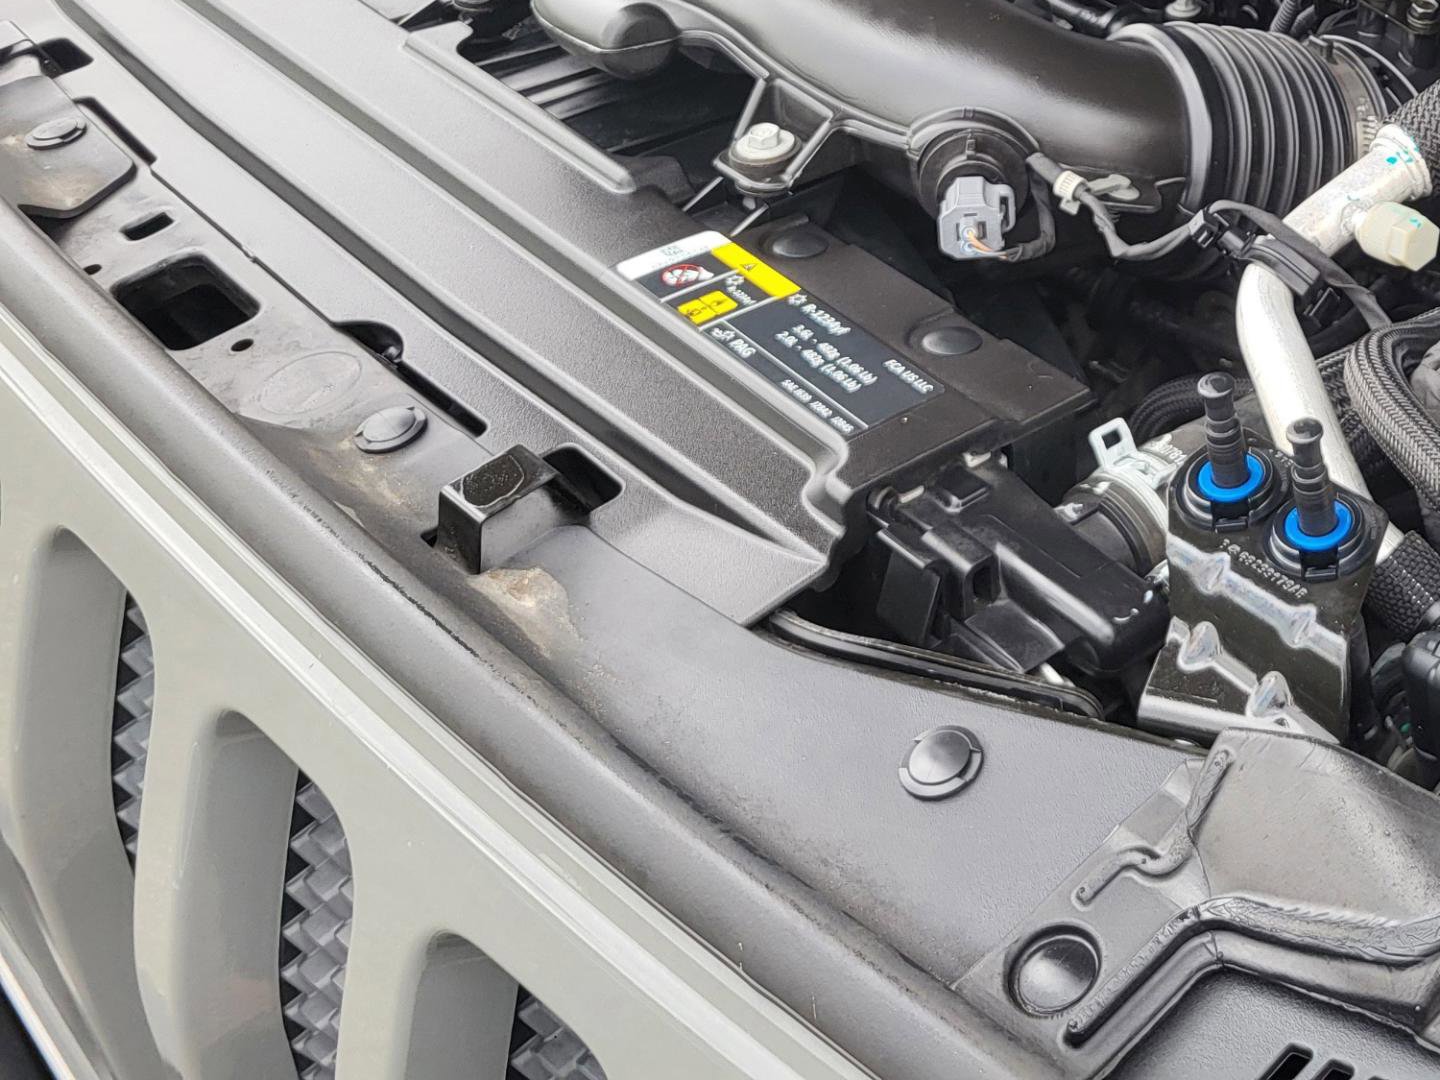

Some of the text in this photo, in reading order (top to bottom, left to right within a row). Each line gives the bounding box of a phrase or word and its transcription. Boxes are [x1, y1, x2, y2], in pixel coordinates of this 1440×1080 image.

[728, 339, 756, 358] PAG
[900, 370, 919, 384] US
[911, 378, 934, 394] LLC
